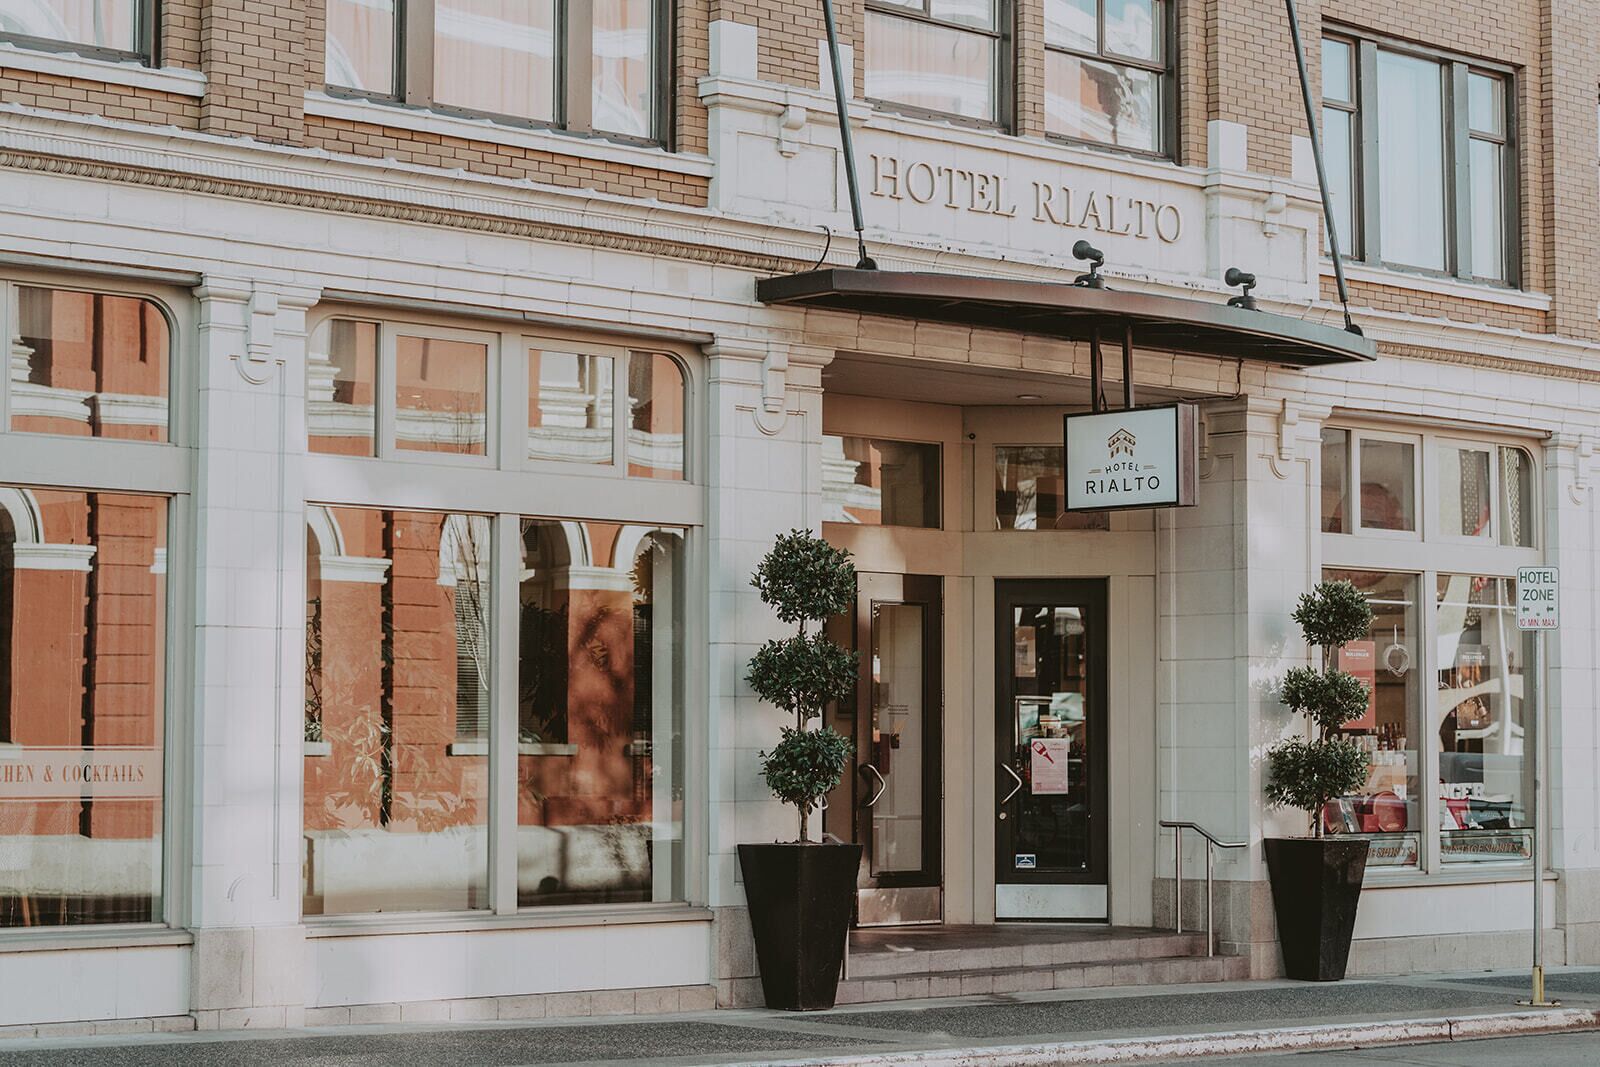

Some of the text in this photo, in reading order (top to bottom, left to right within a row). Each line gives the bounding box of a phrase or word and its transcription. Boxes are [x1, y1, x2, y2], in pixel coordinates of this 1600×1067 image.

[870, 153, 1183, 243] HOTEL RIALTO
[1105, 462, 1140, 474] HOTEL
[1085, 475, 1160, 495] RIALTO
[1519, 571, 1557, 583] HOTEL
[1522, 588, 1554, 601] ZONE
[0, 764, 144, 782] HEN & COCKTAILS
